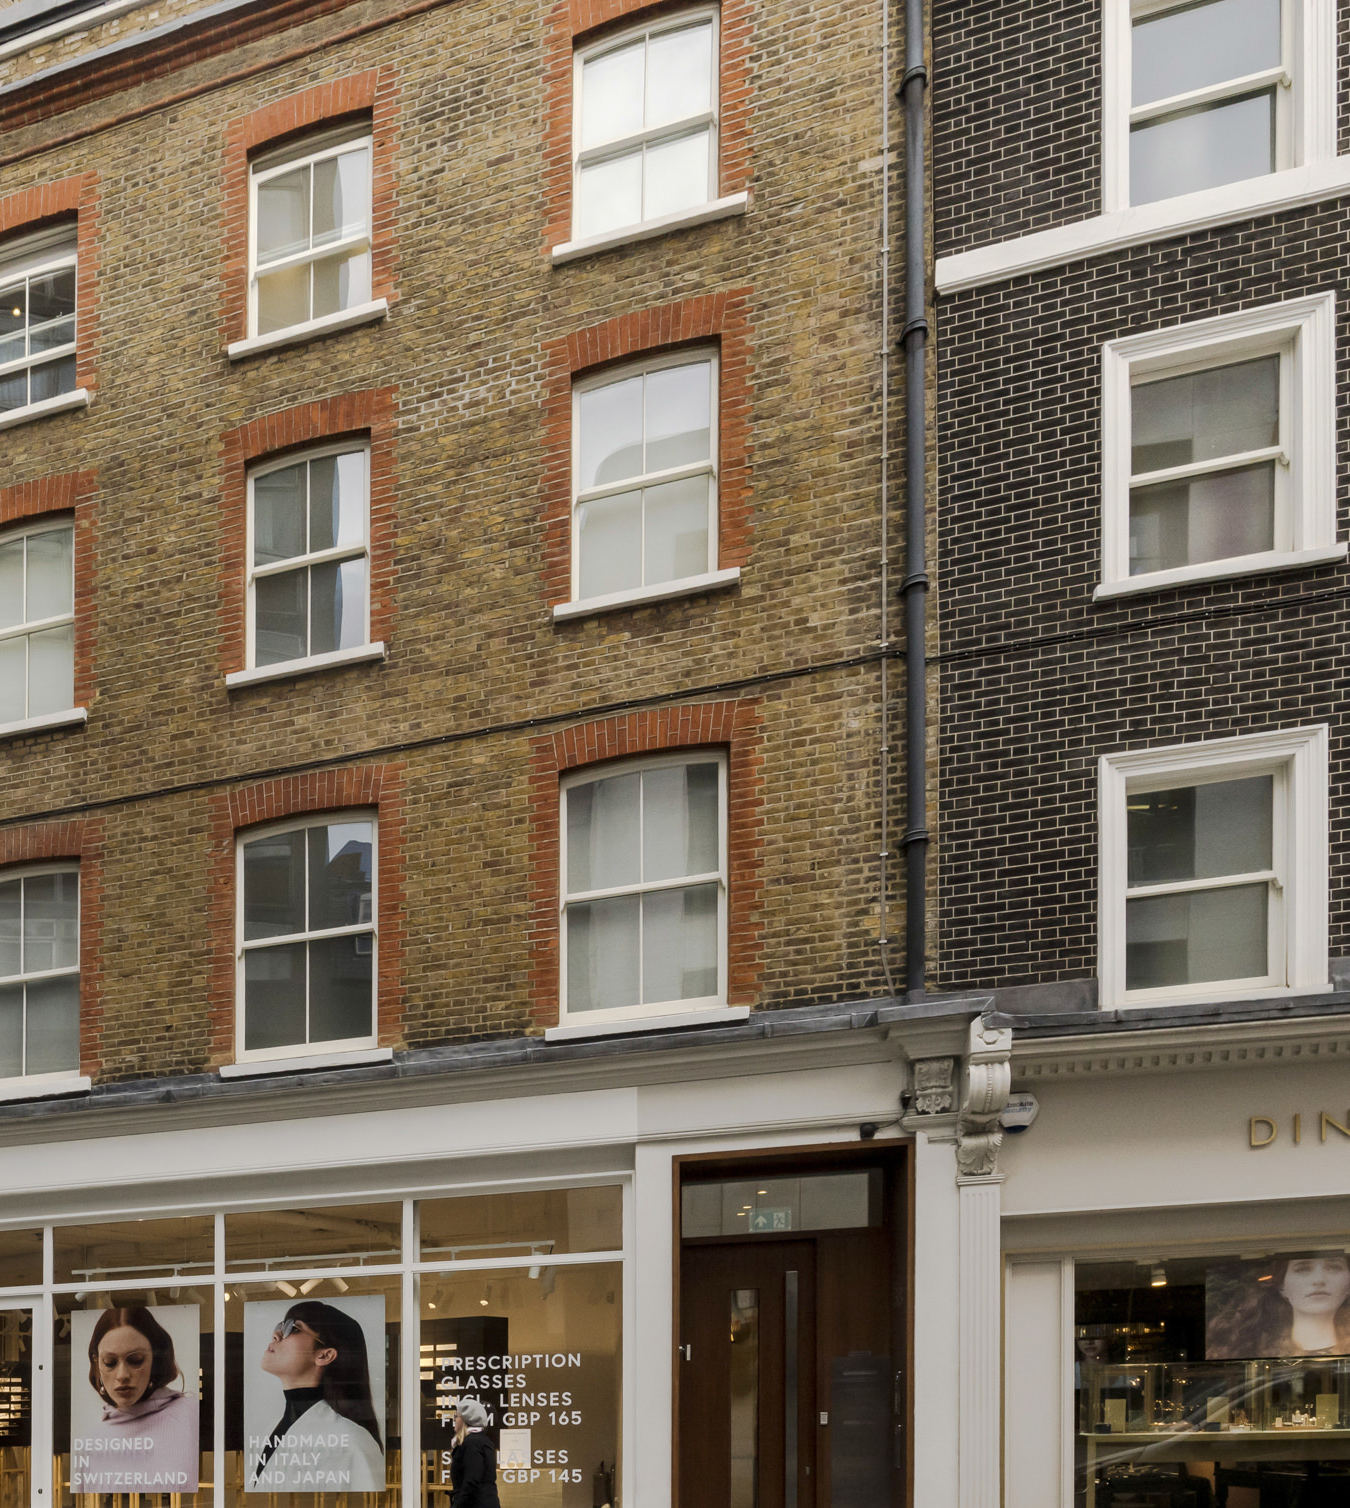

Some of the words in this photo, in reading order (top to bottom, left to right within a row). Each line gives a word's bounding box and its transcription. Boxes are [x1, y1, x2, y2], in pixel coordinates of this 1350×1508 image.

[441, 1353, 581, 1371] PRESCRIPTION
[441, 1374, 527, 1390] GLASSES
[499, 1392, 572, 1407] LENSES
[502, 1412, 541, 1426] GBP
[548, 1411, 582, 1426] 165
[73, 1437, 154, 1451] DESIGNED
[249, 1434, 350, 1449] HANDMADE
[74, 1455, 90, 1468] IN
[250, 1453, 266, 1466] IN
[274, 1452, 321, 1466] ITALY
[73, 1472, 188, 1485] SWITZERLAND
[248, 1471, 286, 1484] AND
[292, 1470, 350, 1484] JAPAN
[502, 1469, 541, 1483] GBP
[548, 1469, 582, 1483] 145
